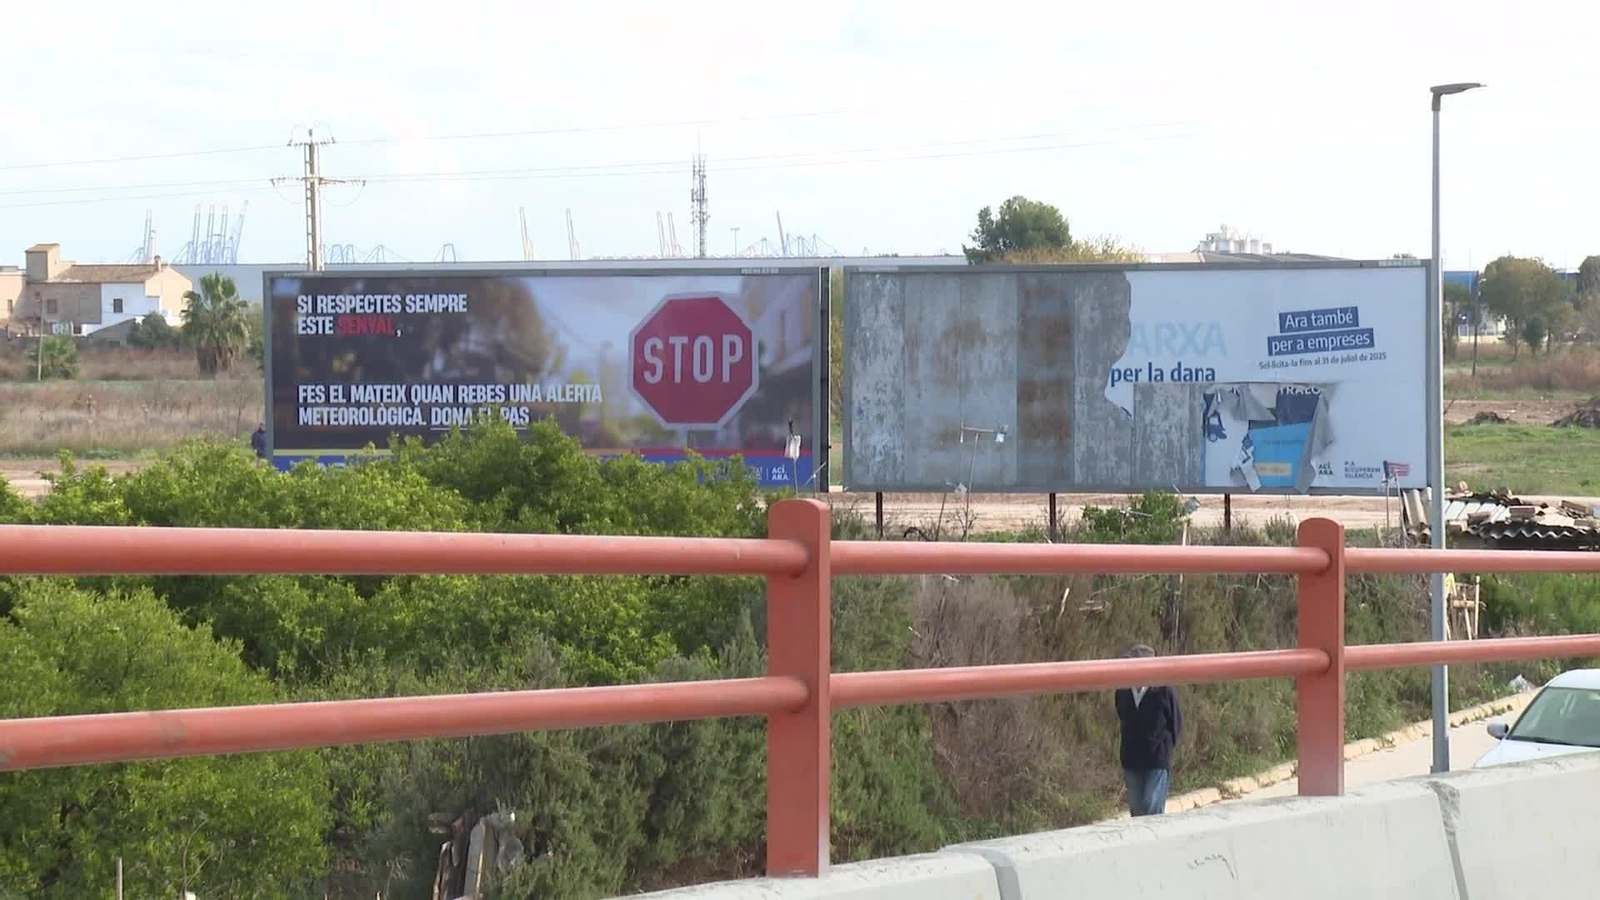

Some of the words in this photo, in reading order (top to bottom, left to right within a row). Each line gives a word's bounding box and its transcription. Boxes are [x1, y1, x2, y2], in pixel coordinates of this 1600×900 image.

[297, 295, 312, 313] SI
[316, 295, 402, 313] RESPECTES
[405, 294, 468, 313] SEMPRE
[297, 316, 334, 335] ESTE
[1285, 314, 1308, 329] Ara
[1311, 310, 1354, 327] també
[1272, 340, 1293, 355] per
[1296, 339, 1305, 350] a
[1307, 333, 1371, 351] empreses
[643, 333, 744, 385] STOP
[1299, 358, 1313, 367] fins
[1314, 357, 1321, 366] al
[1330, 355, 1340, 364] de
[1359, 353, 1368, 362] de
[1110, 367, 1142, 387] per
[1147, 361, 1164, 382] la
[1170, 361, 1216, 382] dana
[298, 385, 325, 403] FES
[329, 385, 347, 403] EL
[350, 384, 410, 403] MATEIX
[411, 384, 454, 406] QUAN
[457, 384, 506, 403] REBES
[509, 384, 542, 403] UNA
[546, 384, 603, 403] ALERTA
[298, 403, 427, 426] METEOROLÒGICA.
[431, 406, 473, 425] DONA
